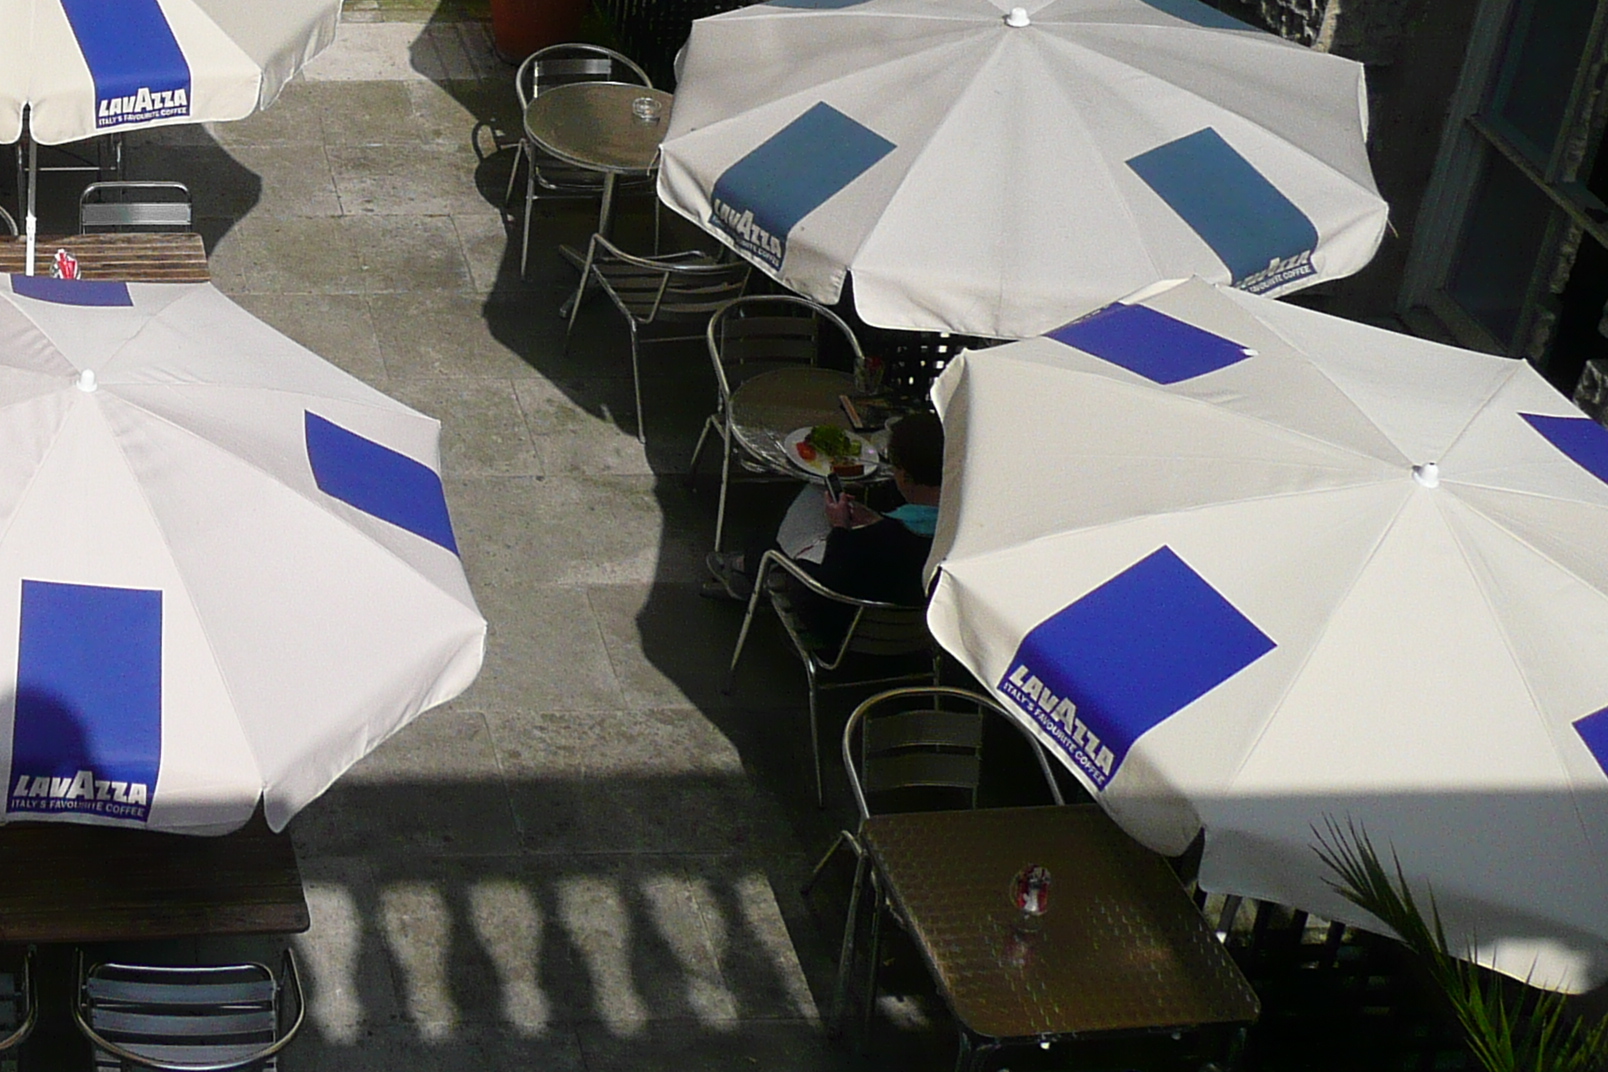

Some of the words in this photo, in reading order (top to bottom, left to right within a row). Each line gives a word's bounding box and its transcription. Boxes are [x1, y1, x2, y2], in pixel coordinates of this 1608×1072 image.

[98, 87, 188, 117] LAVAZZA
[713, 198, 782, 259] LAVAZZA
[1003, 681, 1035, 712] ITALY'S
[1033, 707, 1078, 754] FAVOURITE
[1074, 750, 1106, 786] COFFEE
[1008, 664, 1115, 777] LAVAZZA
[13, 770, 147, 806] LAVAZZA
[105, 803, 146, 817] COFFEE
